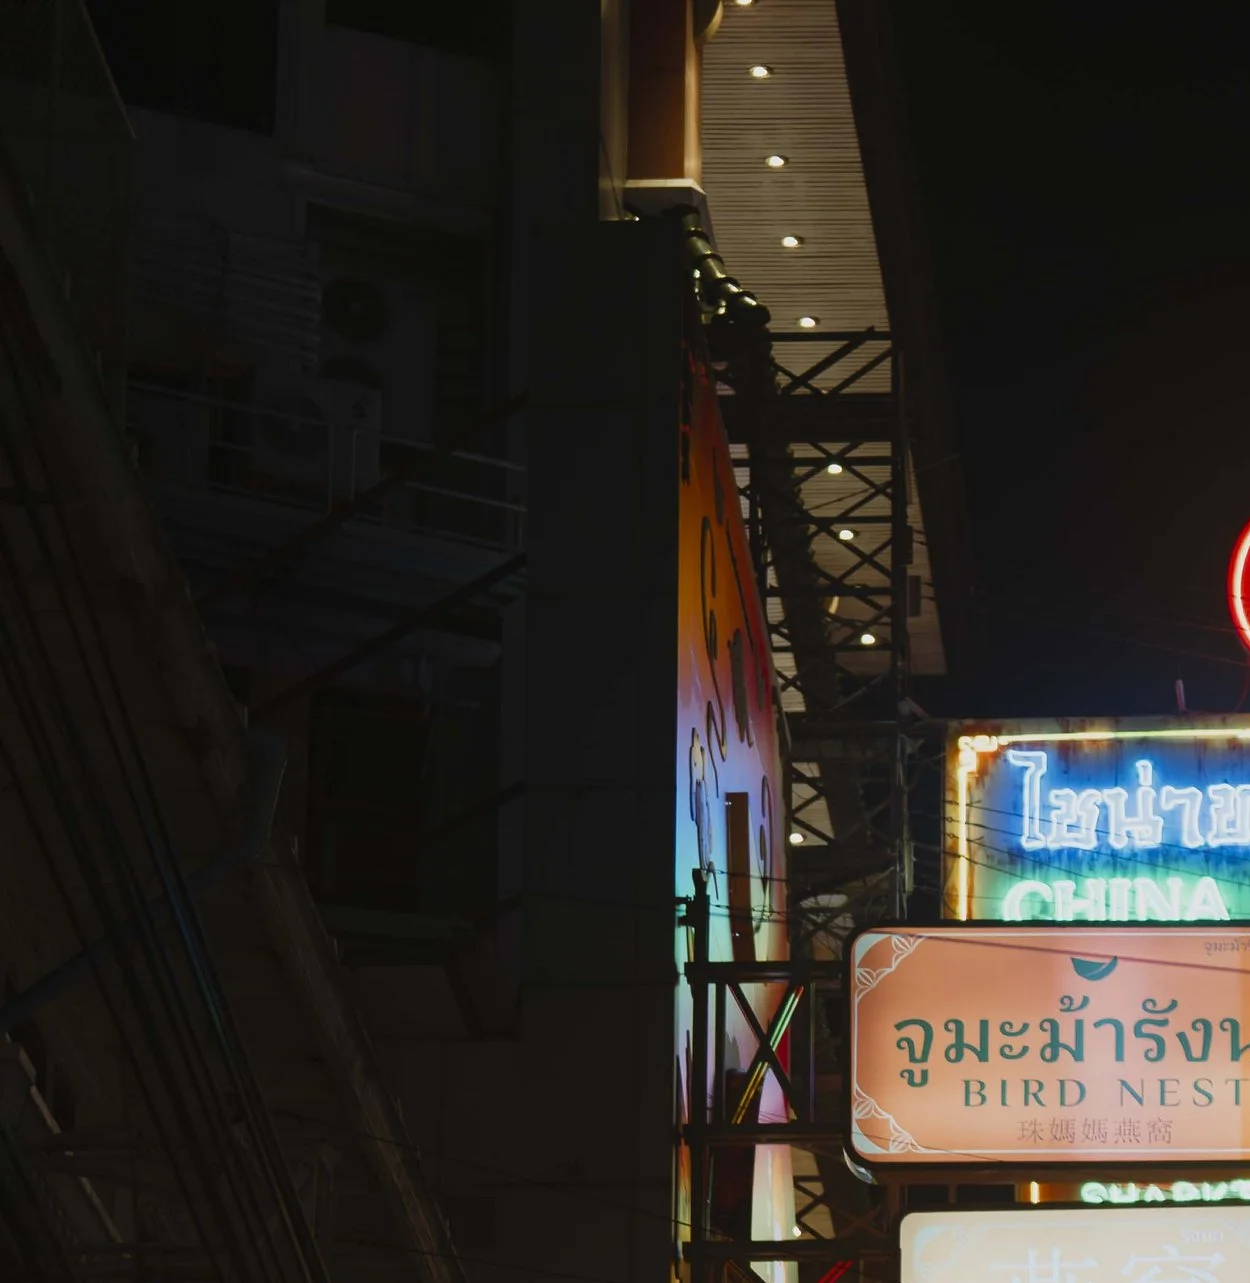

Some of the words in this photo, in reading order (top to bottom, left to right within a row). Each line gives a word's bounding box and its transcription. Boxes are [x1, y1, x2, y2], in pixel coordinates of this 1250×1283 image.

[1003, 875, 1229, 921] CHINA
[962, 1077, 1087, 1108] BIRD
[1119, 1077, 1250, 1107] NEST
[1016, 1116, 1174, 1147] 珠媽媽燕窩
